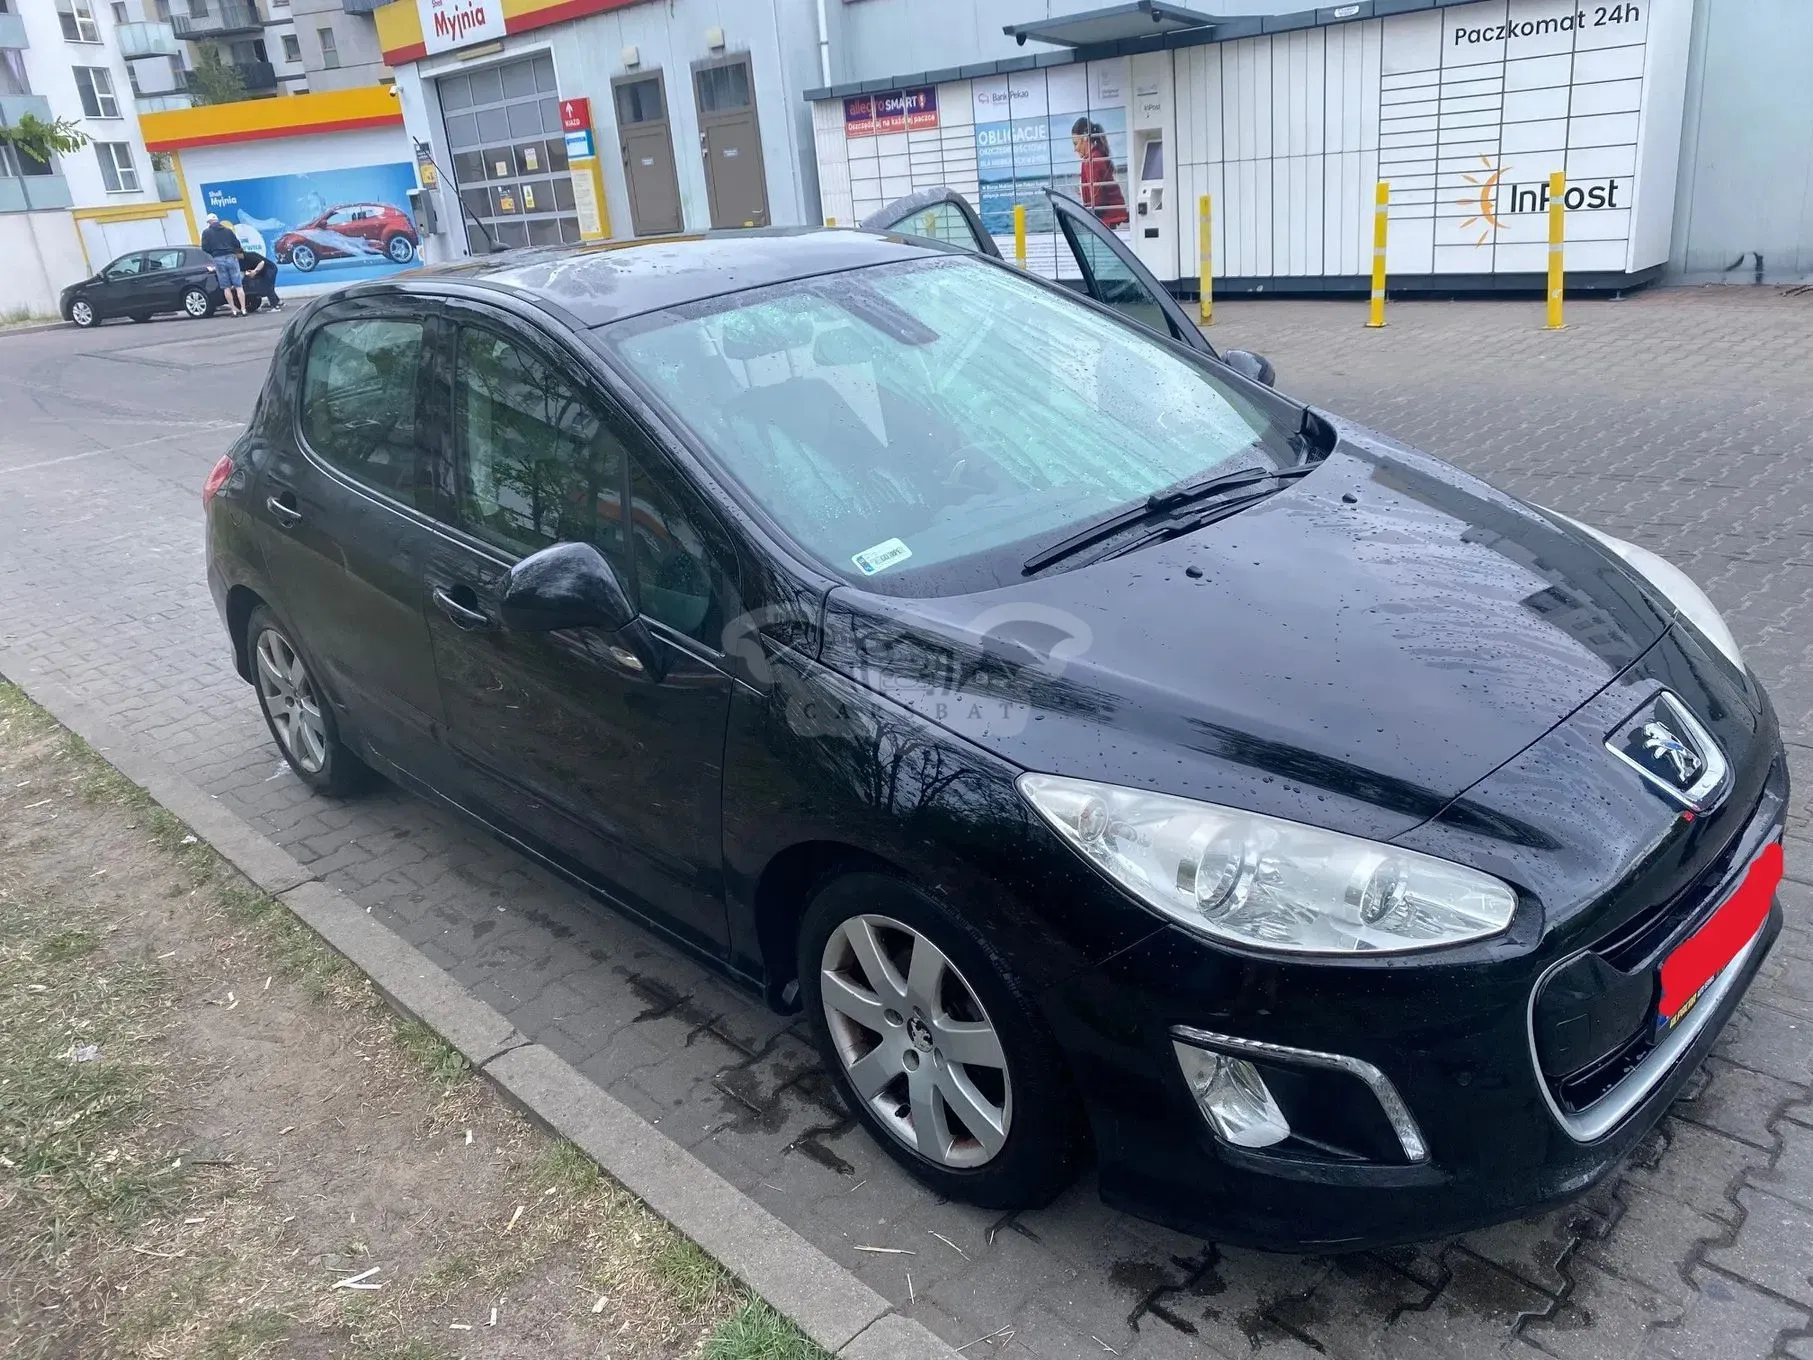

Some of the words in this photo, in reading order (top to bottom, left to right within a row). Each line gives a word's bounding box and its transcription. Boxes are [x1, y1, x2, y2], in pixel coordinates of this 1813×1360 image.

[434, 1, 486, 41] Myjnia
[1455, 11, 1586, 45] Paczkomat
[1594, 3, 1640, 27] 24h
[978, 125, 1046, 146] OBLIGACJE
